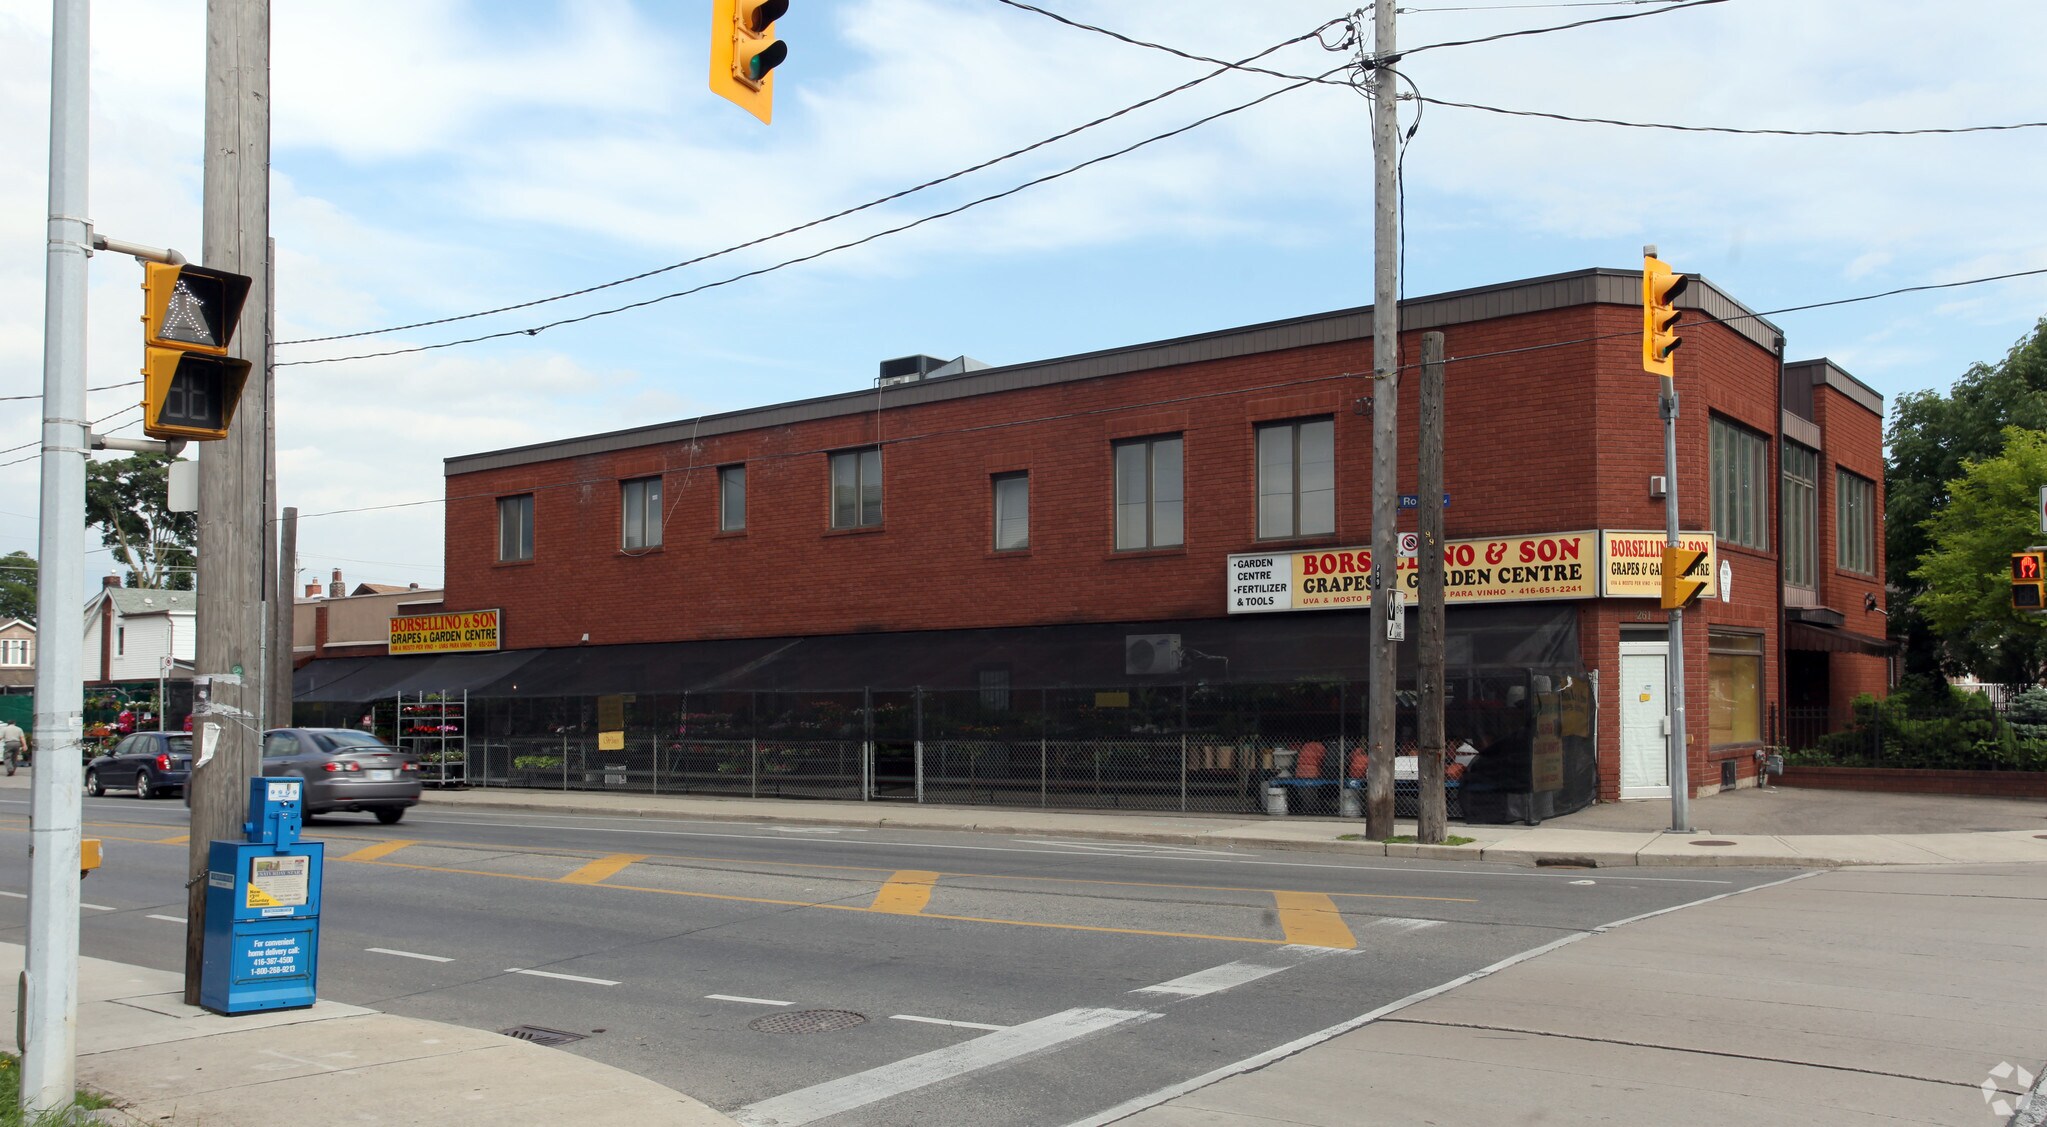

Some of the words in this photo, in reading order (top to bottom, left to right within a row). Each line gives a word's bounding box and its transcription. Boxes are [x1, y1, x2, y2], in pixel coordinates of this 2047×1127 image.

[1485, 542, 1508, 565] &
[1519, 538, 1581, 563] SON
[1237, 558, 1273, 568] GARDEN
[1611, 562, 1640, 576] GRAPES
[1642, 562, 1648, 576] &
[1237, 571, 1272, 581] CENTRE
[1407, 568, 1491, 589] GDEN
[1498, 563, 1583, 584] CENTRE
[1237, 583, 1287, 594] FERTILIZER
[1519, 585, 1582, 594] 416-651-2241
[1237, 598, 1244, 606] &
[1245, 596, 1274, 606] TOOLS
[1333, 595, 1362, 603] MOSTO
[1636, 610, 1651, 620] 261
[391, 615, 462, 632] BORSELLINO
[464, 617, 470, 628] &
[472, 612, 497, 628] SON
[391, 633, 422, 644] GRAPES
[429, 630, 461, 643] GARDEN
[465, 628, 497, 640] CENTRE
[265, 937, 295, 947] convenient
[247, 949, 264, 957] home
[265, 948, 287, 956] delivery
[288, 946, 300, 954] call:
